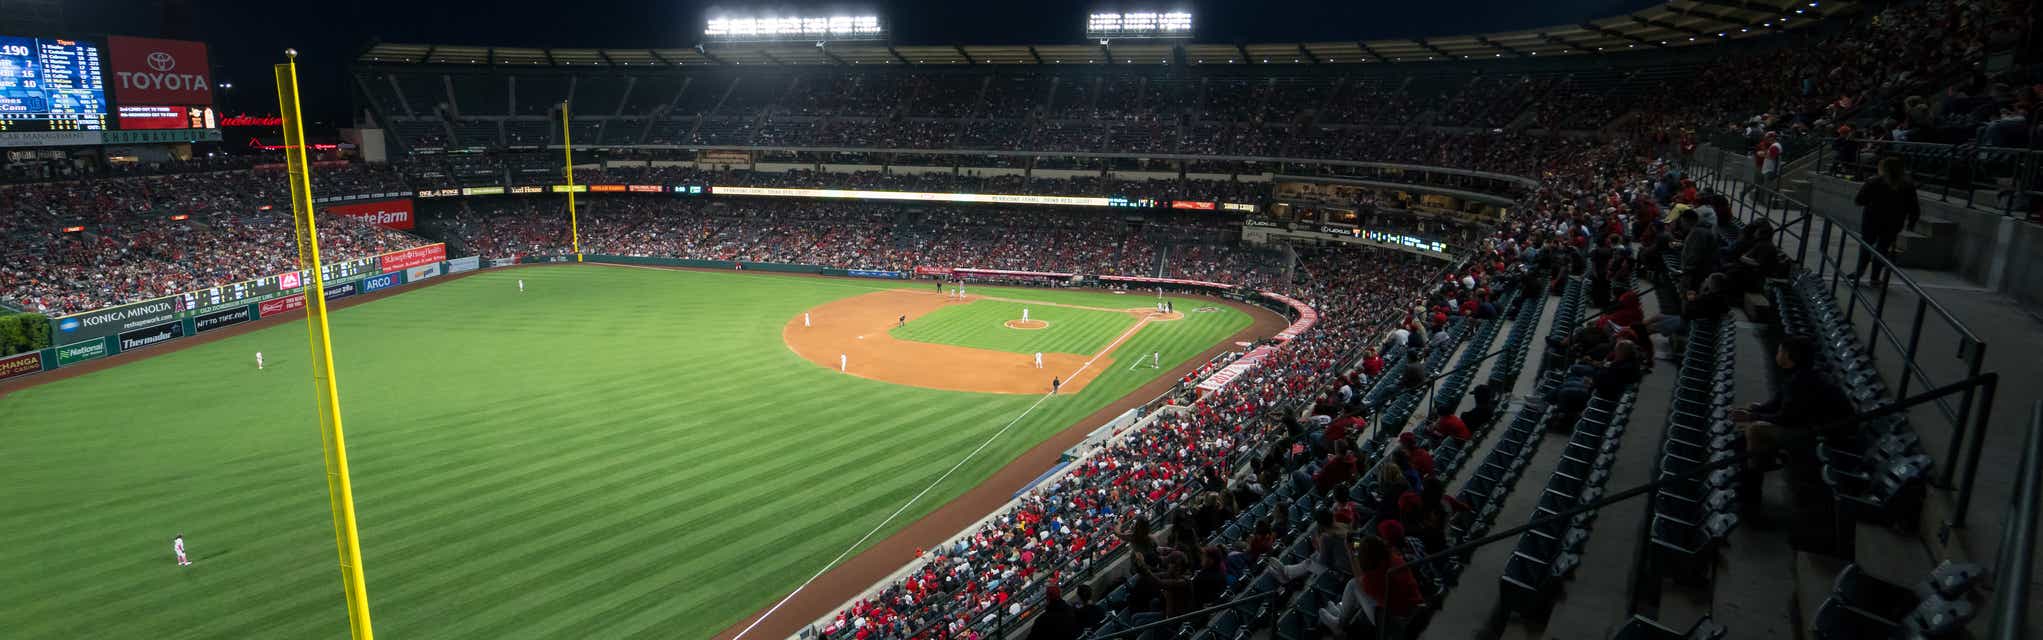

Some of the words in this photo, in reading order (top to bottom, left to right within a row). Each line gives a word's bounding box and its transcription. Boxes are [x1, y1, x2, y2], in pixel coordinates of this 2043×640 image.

[117, 71, 208, 91] TOYOTA
[366, 276, 391, 291] ARCO
[83, 311, 126, 328] KONICA
[127, 302, 172, 319] MINOLTA
[123, 314, 173, 329] reshapework.com
[122, 331, 172, 350] Thermador
[70, 342, 104, 358] National
